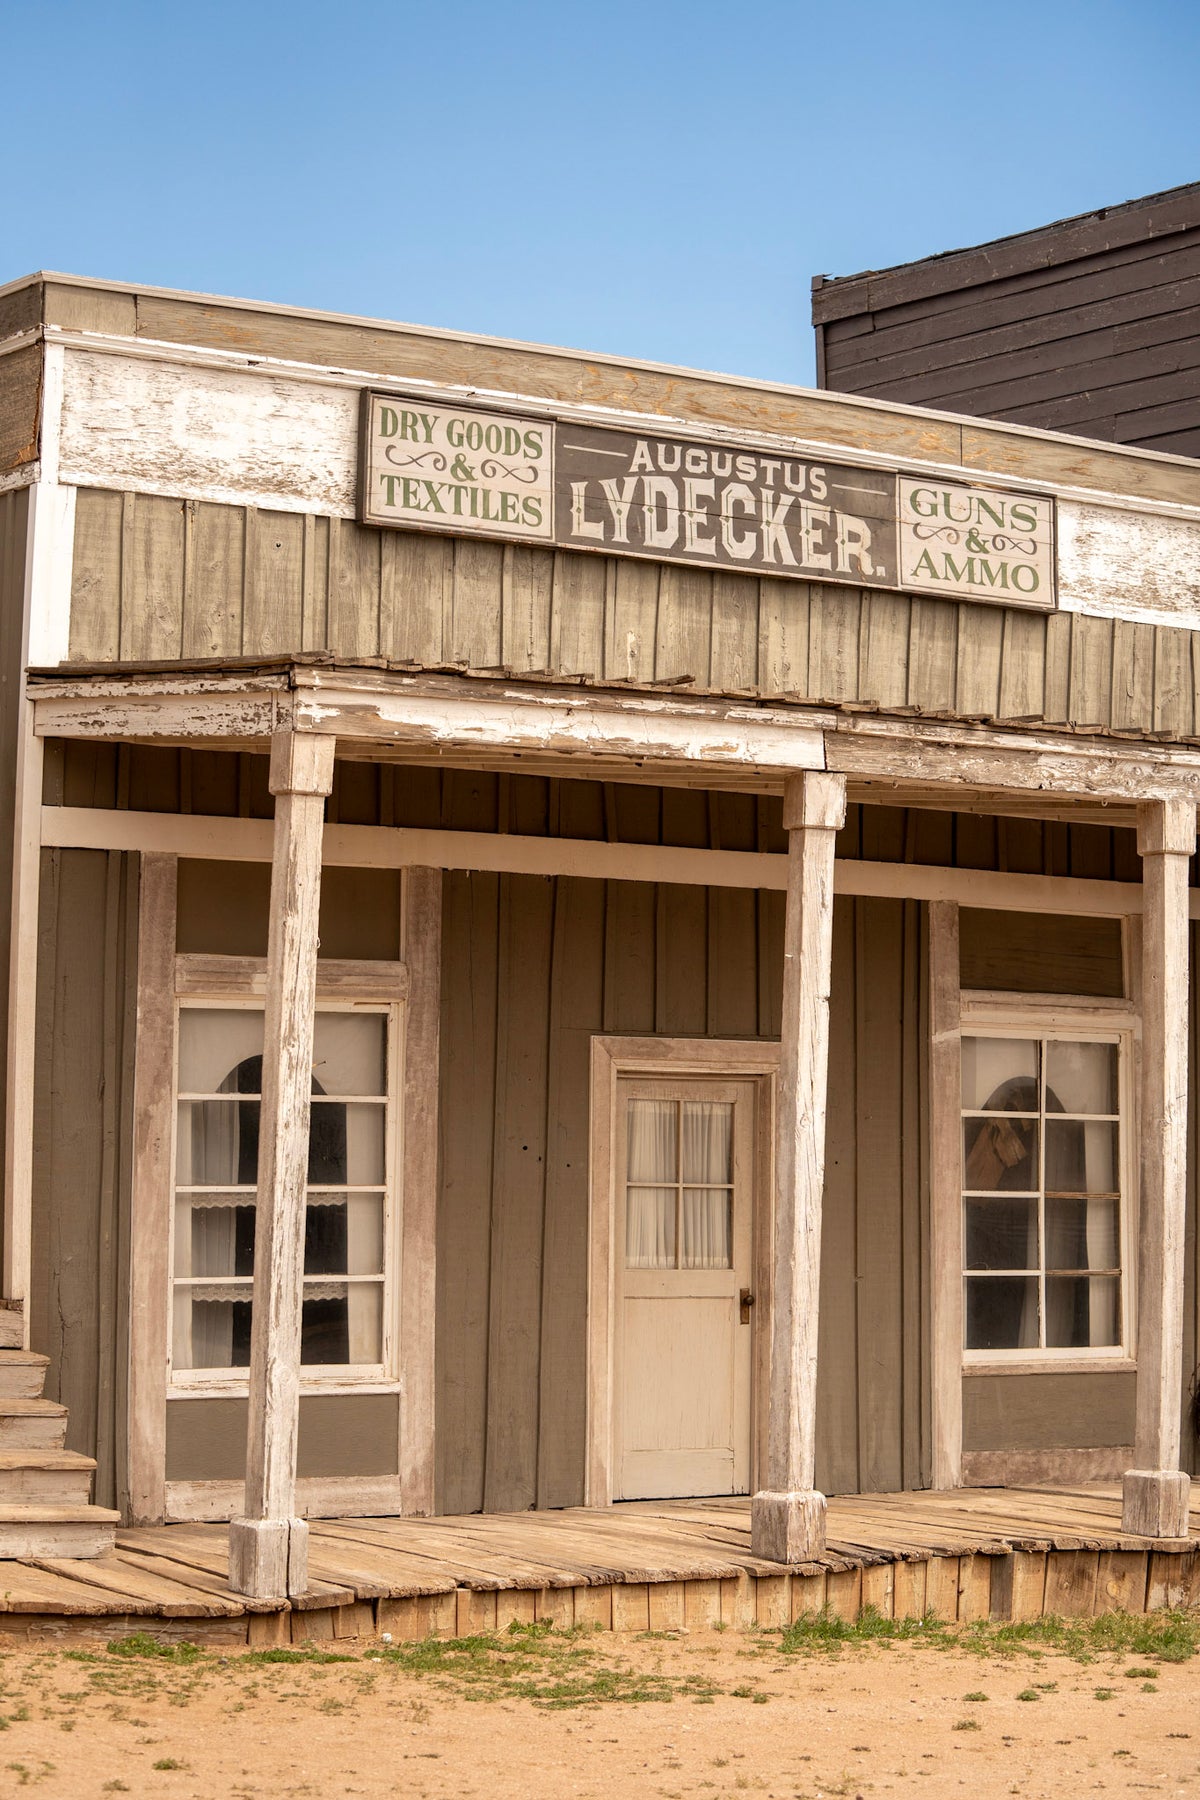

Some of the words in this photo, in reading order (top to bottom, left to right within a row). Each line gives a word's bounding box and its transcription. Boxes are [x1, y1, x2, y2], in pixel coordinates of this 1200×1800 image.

[378, 406, 440, 444] DRY
[446, 419, 543, 460] GOODS
[450, 453, 478, 482] &
[629, 440, 828, 500] AUGUSTUS
[380, 474, 543, 528] TEXTILES
[910, 488, 1038, 533] GUNS
[570, 476, 886, 577] LYDECKER.
[965, 527, 990, 554] &
[910, 548, 1040, 593] AMMO
